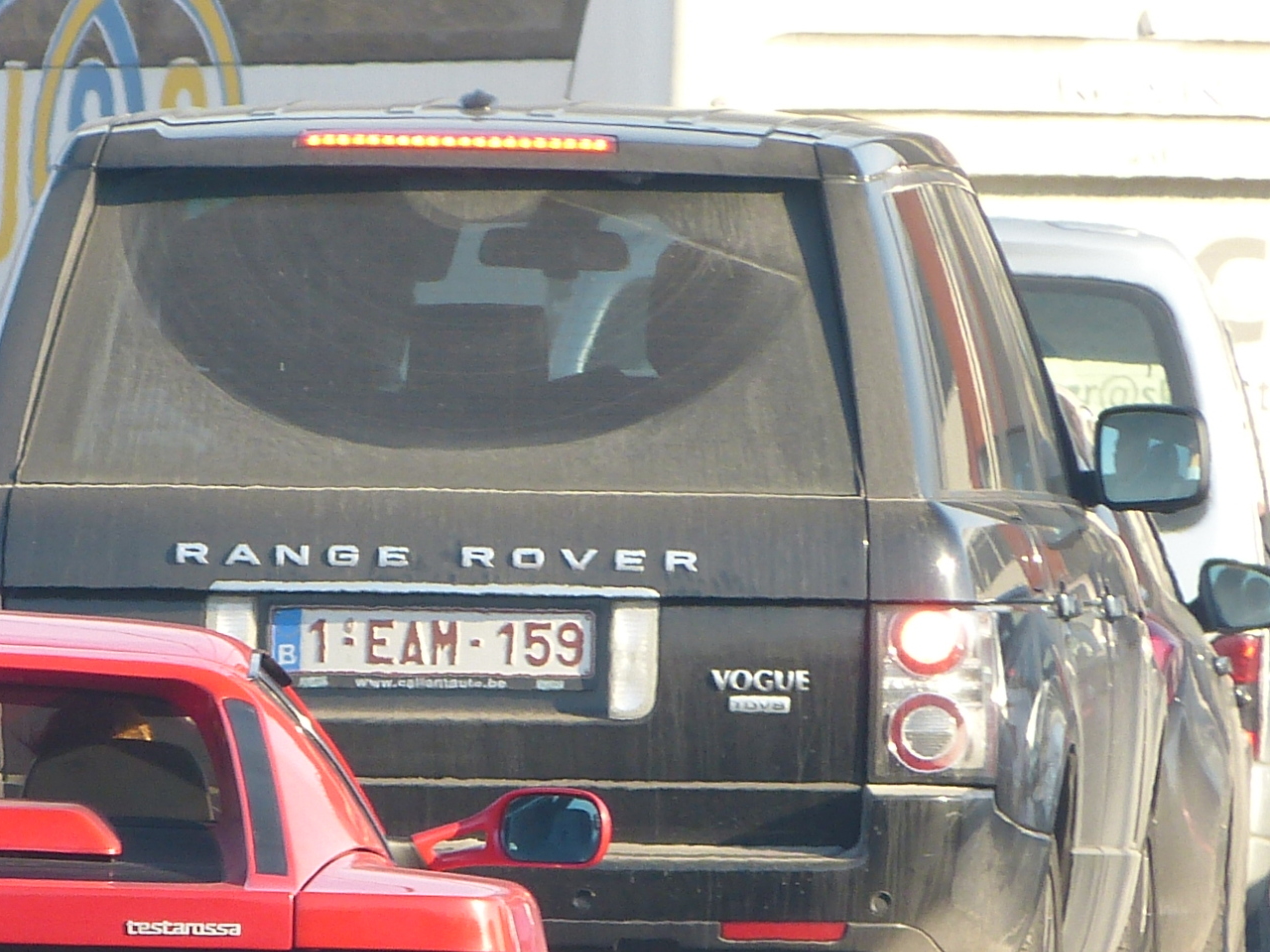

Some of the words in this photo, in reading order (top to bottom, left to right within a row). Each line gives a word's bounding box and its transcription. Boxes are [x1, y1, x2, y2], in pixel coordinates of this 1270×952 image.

[175, 541, 410, 568] RANGE
[461, 547, 698, 573] ROVER
[277, 644, 298, 666] B
[711, 669, 810, 692] VOGUE
[125, 920, 242, 936] testarossa
